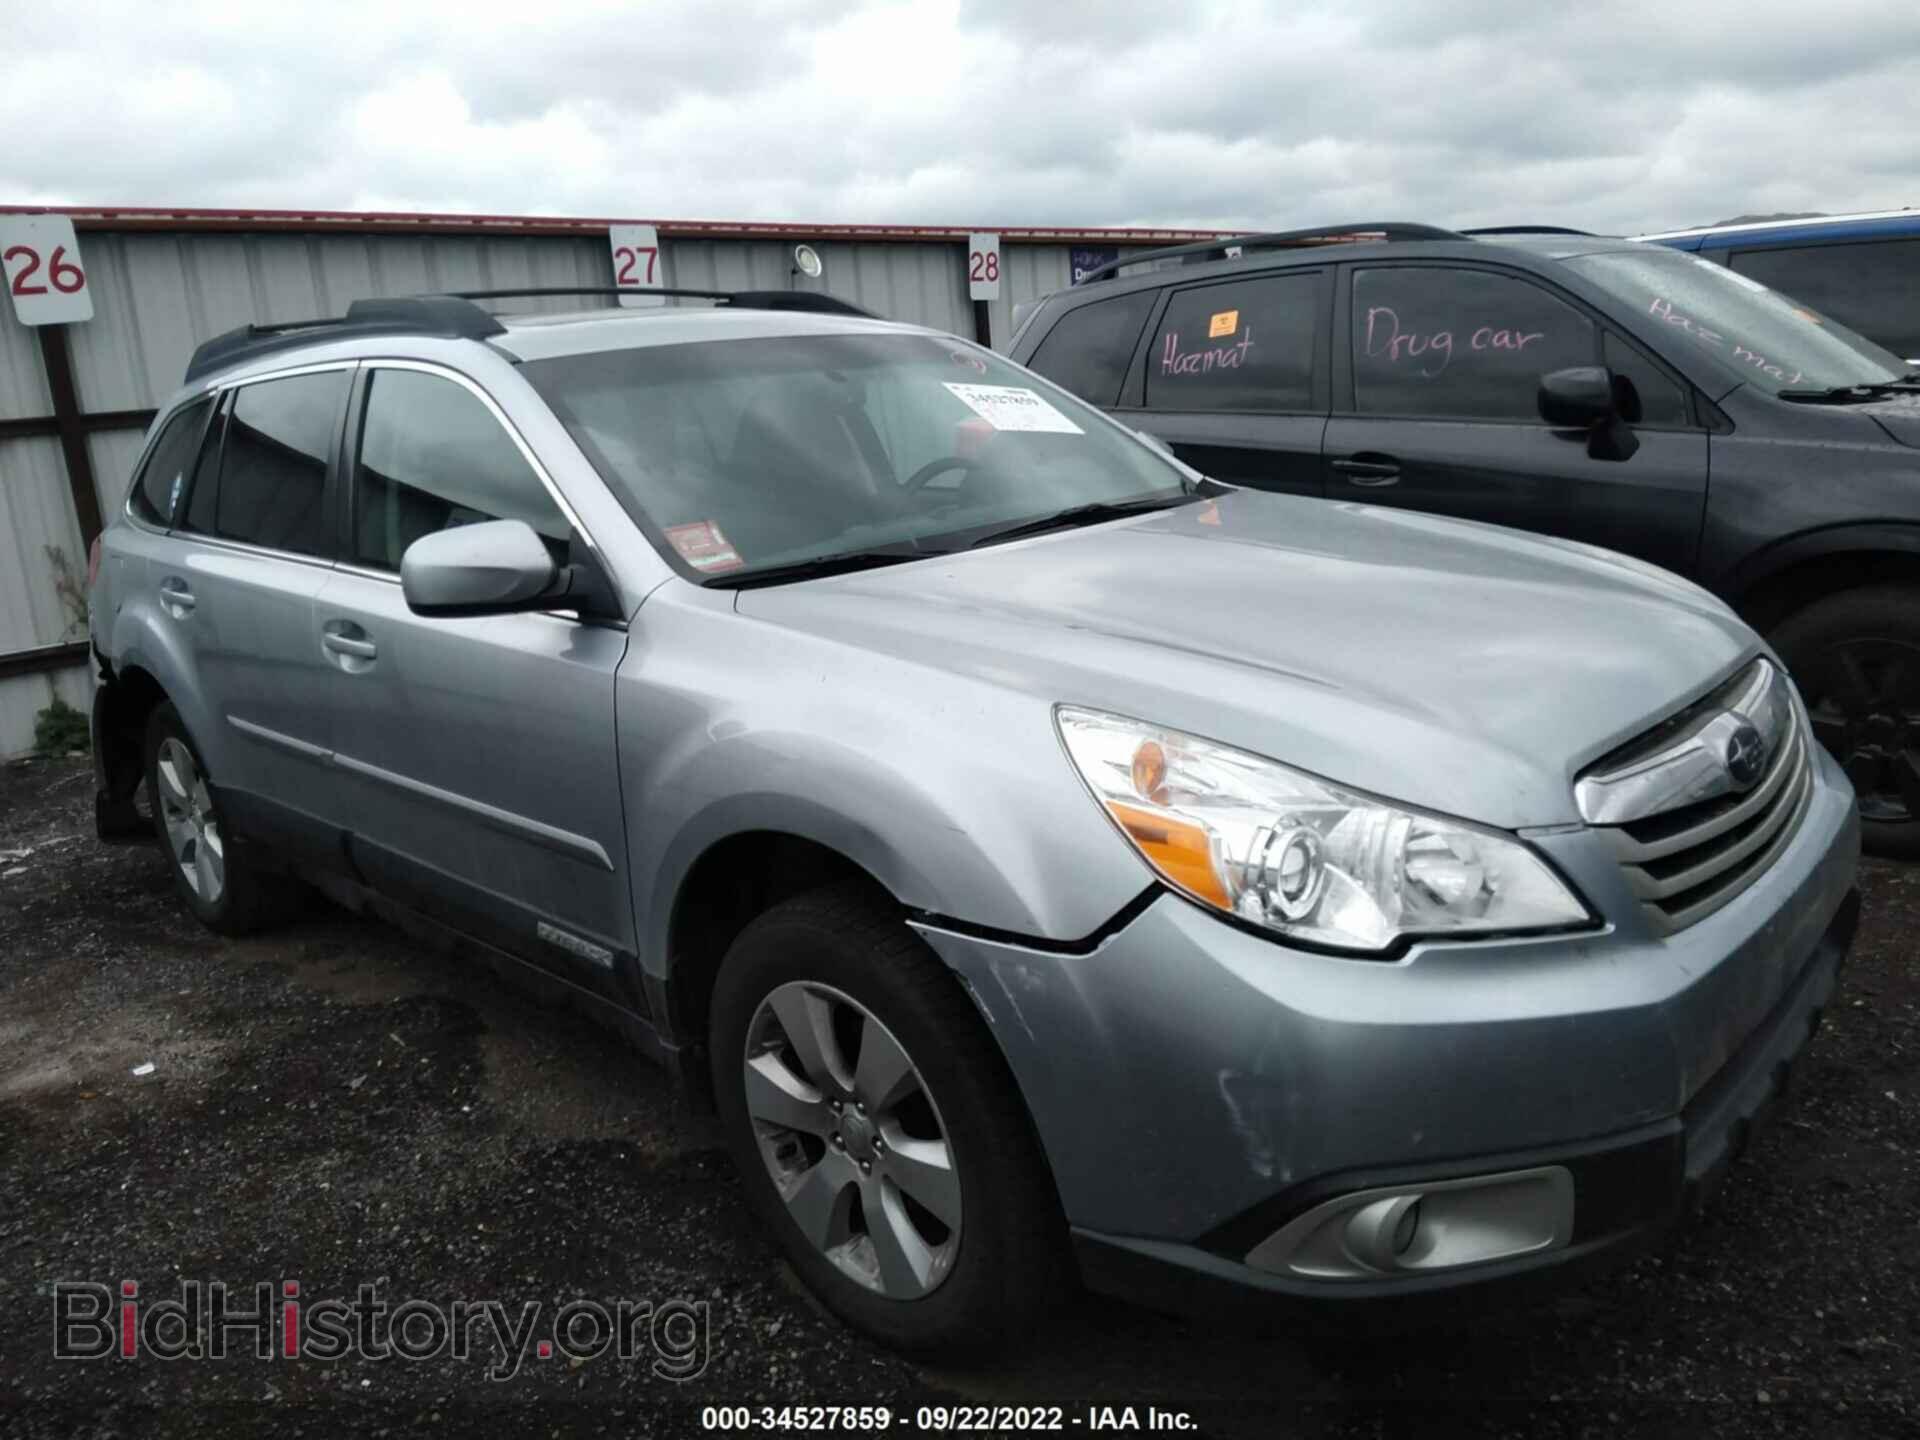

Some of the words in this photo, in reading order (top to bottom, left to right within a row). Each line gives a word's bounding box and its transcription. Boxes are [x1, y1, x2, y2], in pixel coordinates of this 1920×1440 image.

[3, 245, 85, 296] 26
[615, 246, 657, 285] 27
[970, 251, 999, 282] 28
[1162, 326, 1254, 375] Hazmat
[1367, 307, 1454, 377] Drug
[1471, 327, 1545, 350] car
